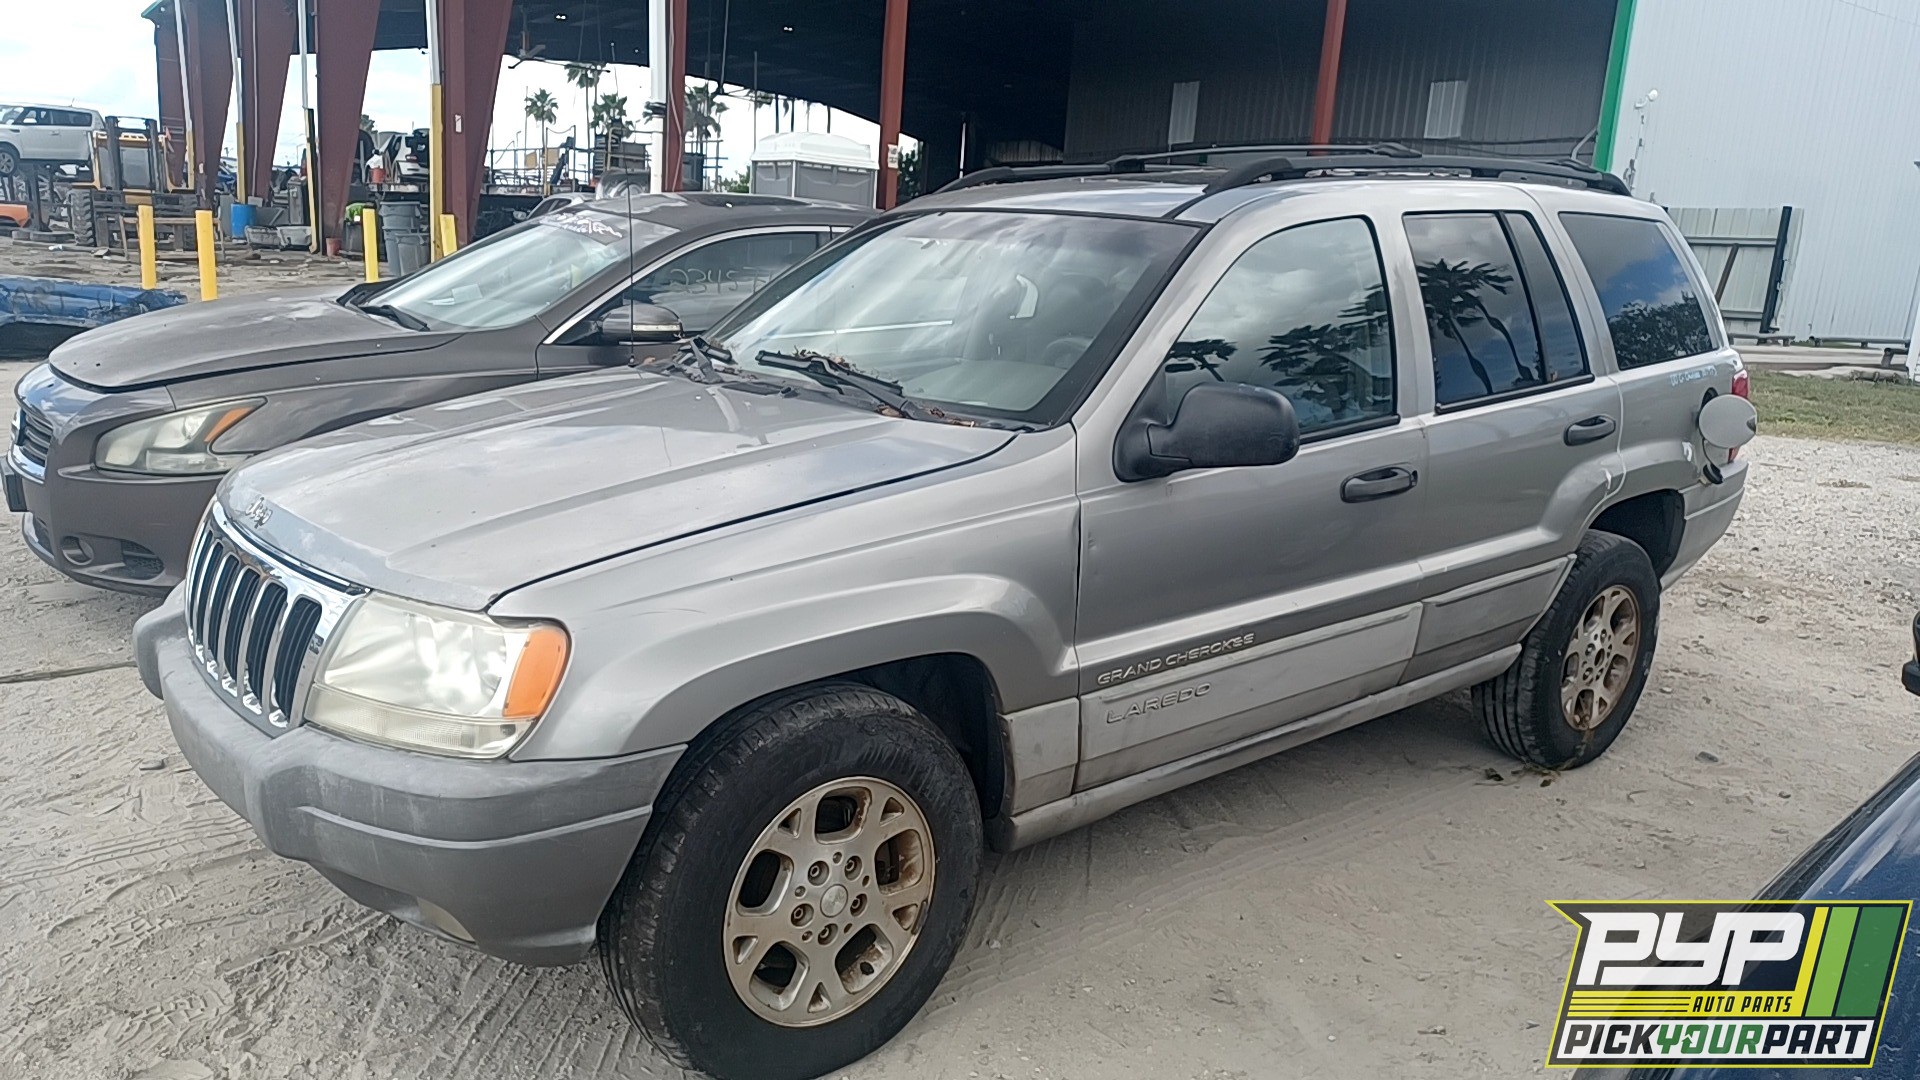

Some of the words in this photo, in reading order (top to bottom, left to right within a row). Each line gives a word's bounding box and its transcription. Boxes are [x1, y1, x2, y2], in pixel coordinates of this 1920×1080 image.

[1097, 658, 1162, 685] GRAND
[1165, 633, 1255, 666] CHEROKEE
[1106, 683, 1211, 723] LAREDO
